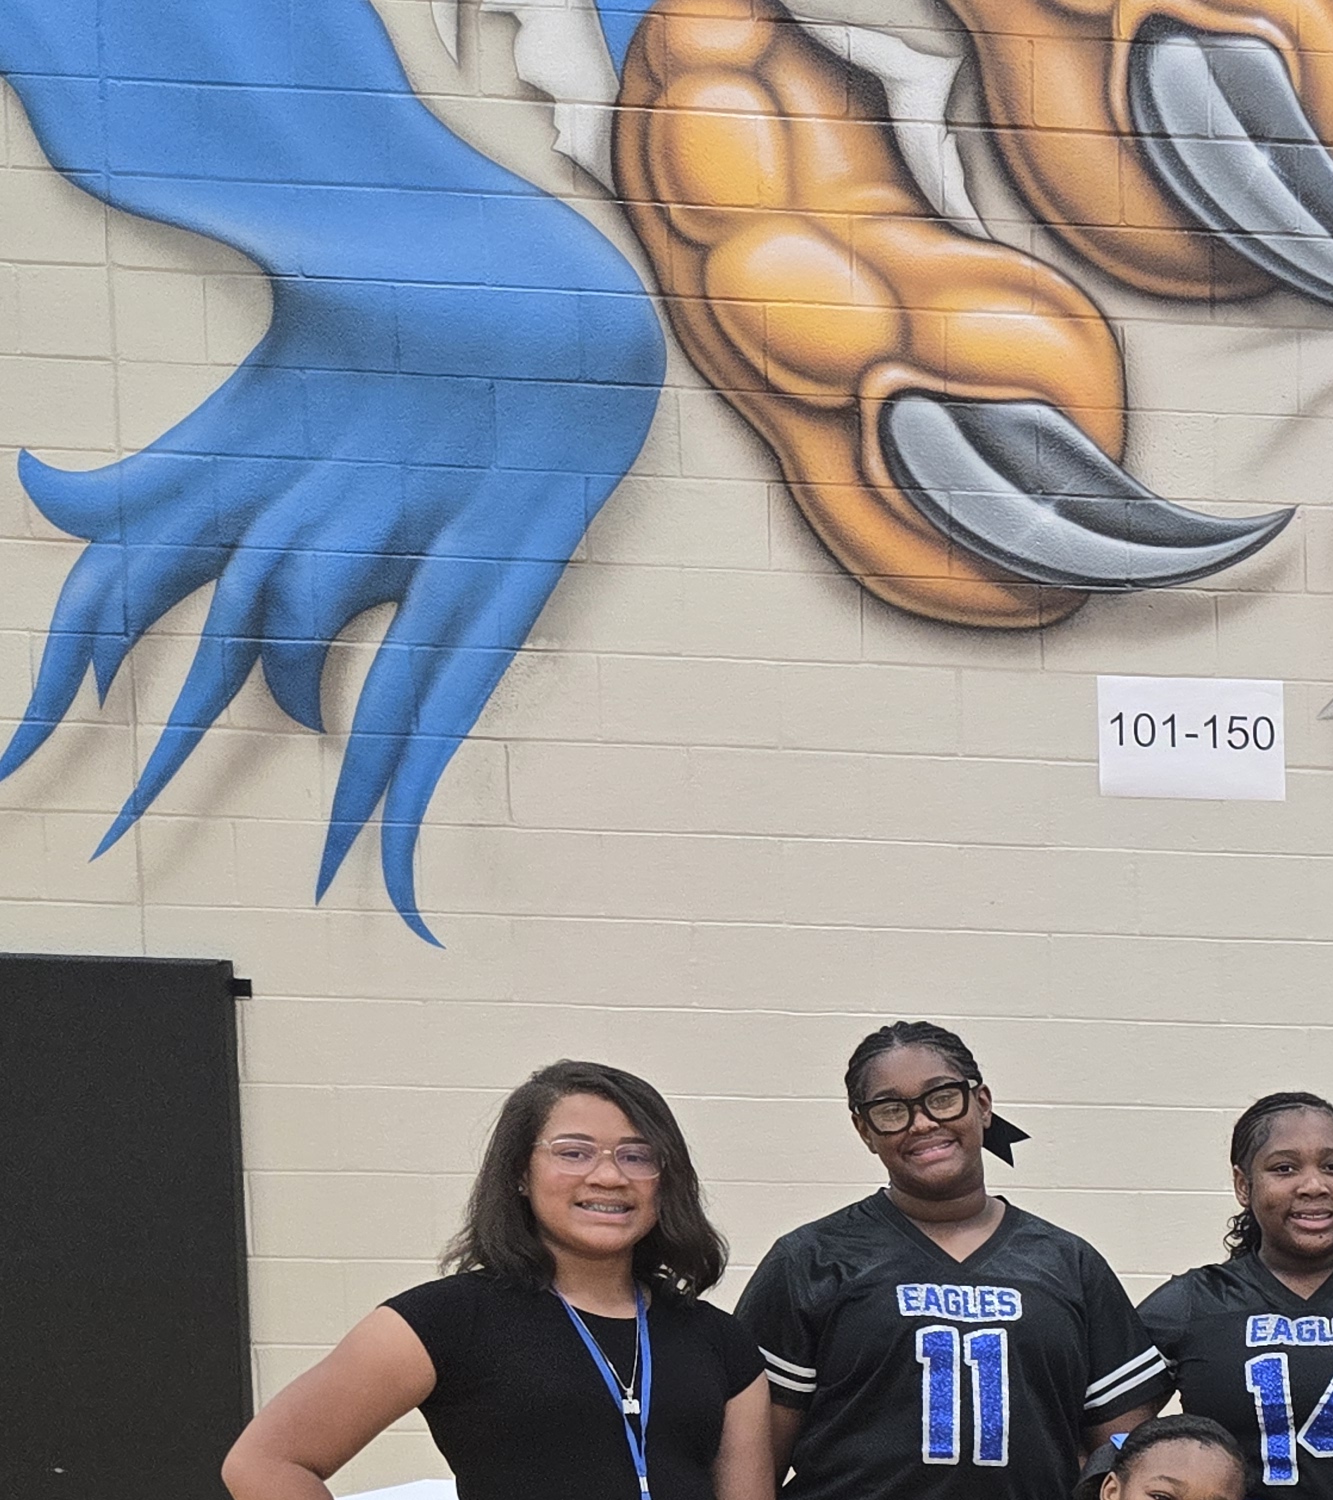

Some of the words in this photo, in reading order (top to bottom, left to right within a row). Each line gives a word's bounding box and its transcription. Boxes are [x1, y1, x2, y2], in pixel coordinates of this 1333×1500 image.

[1109, 711, 1276, 751] 101-150
[896, 1284, 1022, 1321] EAGLES
[915, 1325, 1009, 1467] 11
